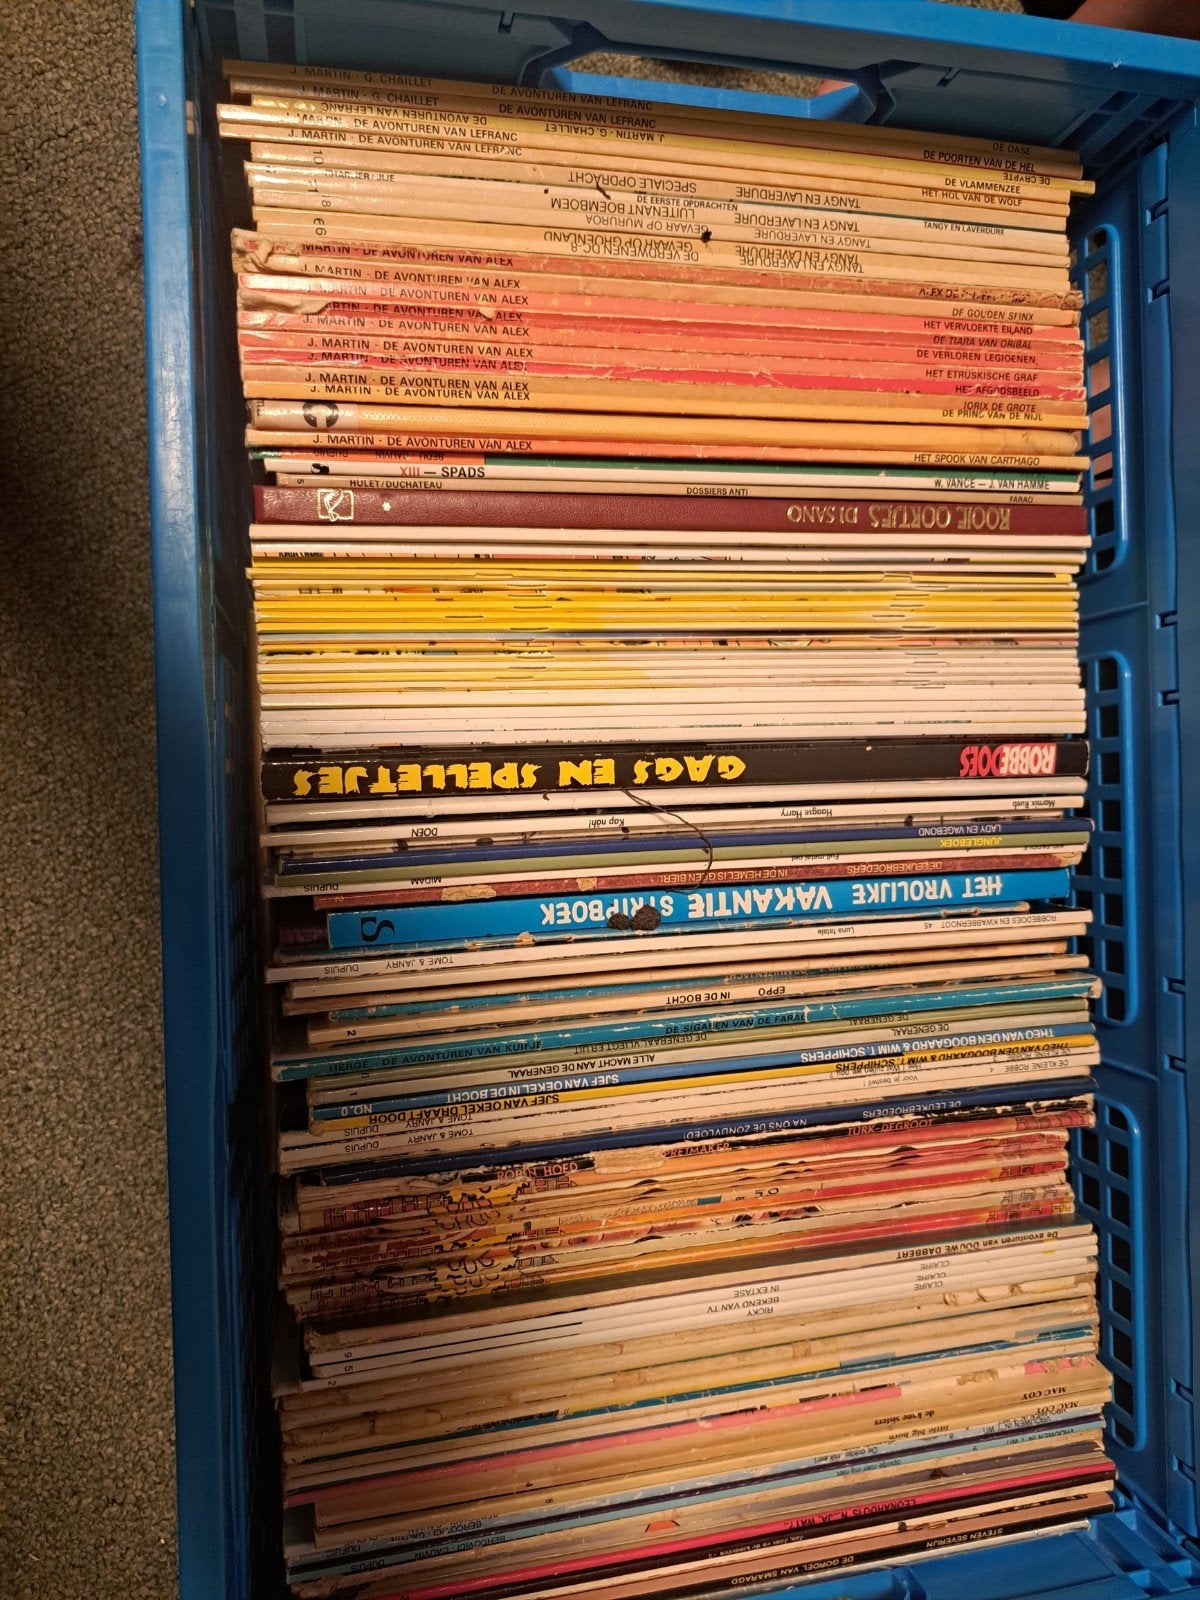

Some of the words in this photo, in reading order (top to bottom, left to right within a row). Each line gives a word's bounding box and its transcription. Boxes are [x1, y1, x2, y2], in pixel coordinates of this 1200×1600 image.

[377, 107, 399, 116] VAN
[402, 109, 470, 123] AVONTUREN
[500, 104, 513, 114] DE
[516, 105, 581, 121] AVONTUREN
[584, 113, 607, 123] VAN
[610, 115, 656, 128] LEFRANC
[473, 115, 487, 125] DE
[924, 150, 936, 159] DE
[939, 152, 981, 166] POORTEN
[984, 157, 1002, 167] VAN
[1005, 160, 1016, 169] DE
[1019, 161, 1036, 172] HEL
[568, 171, 636, 187] OPDRACHT
[639, 178, 696, 193] SPECIALE
[945, 178, 957, 186] DE
[959, 179, 1020, 194] VLAMMENZEE
[736, 186, 802, 202] LAVERDURE
[804, 193, 821, 204] EN
[551, 198, 623, 214] BOEMBOEM
[651, 196, 680, 207] EERSTE
[683, 199, 738, 211] OPDRACHTEN
[828, 196, 860, 208] TANGY
[626, 206, 695, 219] LUITENANT
[924, 221, 948, 230] TANGY
[962, 225, 1005, 235] LAVERDURE
[755, 229, 817, 243] LAVERDURE
[821, 235, 834, 244] EN
[837, 237, 871, 247] TANGY
[924, 321, 941, 329] HET
[944, 322, 999, 332] VERVLOEKTE
[308, 338, 317, 346] J.
[323, 338, 369, 349] MARTIN
[383, 341, 398, 350] DE
[400, 342, 475, 354] AVONTUREN
[478, 345, 500, 355] VAN
[506, 347, 533, 357] ALEX
[917, 350, 929, 358] DE
[932, 350, 981, 361] VERLOREN
[925, 369, 943, 378] HET
[947, 370, 1010, 381] ETRUSKISCHE
[1014, 373, 1038, 382] GRAF
[313, 434, 323, 444] J.
[327, 435, 374, 446] MARTIN
[387, 437, 402, 446] DE
[405, 437, 475, 449] AVONTUREN
[479, 439, 501, 449] VAN
[506, 440, 532, 450] ALEX
[914, 453, 932, 463] HET
[935, 454, 965, 464] SPOOK
[968, 455, 987, 464] VAN
[991, 456, 1040, 466] CARTHAGO
[400, 467, 420, 477] XIII
[441, 466, 485, 478] SPADS
[350, 479, 442, 489] HULET/DUCHATEAU
[934, 478, 944, 488] W.
[946, 478, 975, 488] VANCE
[989, 479, 996, 489] J.
[998, 480, 1014, 489] VAN
[1018, 480, 1049, 490] HAMME
[686, 487, 728, 496] DOSSIERS
[730, 487, 748, 496] ANTI
[1009, 495, 1033, 504] FARAO
[787, 504, 834, 525] SANO
[869, 505, 952, 530] OORTJES
[960, 743, 1057, 777] ROBBEDOES
[558, 758, 615, 787] EN
[632, 754, 746, 784] GAGS
[293, 761, 542, 796] SPELLETJES
[781, 809, 802, 818] Harry
[804, 808, 832, 818] Haagse
[411, 828, 438, 838] DOEN
[919, 826, 964, 836] VAGEBOND
[978, 824, 1001, 834] LADY
[940, 837, 1002, 847] JUNGLEBOEK
[962, 875, 1002, 897] HET
[852, 880, 953, 904] VROLIJKE
[688, 885, 833, 918] VAKANTIE
[941, 917, 1000, 928] KWABBERNOOT
[1012, 915, 1056, 925] ROBBEDOES
[386, 960, 415, 969] JANRY
[428, 956, 454, 965] TOME
[324, 964, 359, 974] DUPUIS
[758, 986, 785, 996] EPPO
[666, 994, 701, 1004] BOCHT
[703, 993, 717, 1001] DE
[891, 1025, 936, 1035] GENERAAL
[1025, 1028, 1054, 1039] THEO
[977, 1033, 1000, 1044] DEN
[1002, 1031, 1024, 1042] VAN
[878, 1043, 900, 1054] WIM
[911, 1036, 975, 1050] BOOGAARD
[633, 1054, 655, 1063] ALLE
[801, 1047, 866, 1063] SCHIPPERS
[578, 1061, 597, 1070] AAN
[599, 1057, 631, 1068] MACHT
[508, 1066, 561, 1077] GENERAAL
[565, 1079, 589, 1089] VAN
[592, 1075, 619, 1085] SJEF
[491, 1088, 507, 1096] DE
[523, 1082, 562, 1094] OEKEL
[447, 1091, 487, 1103] BOCHT
[863, 1102, 946, 1118] LEUKEBROEDERS
[948, 1101, 961, 1109] DE
[768, 1121, 790, 1130] ONS
[792, 1118, 807, 1126] NA
[683, 1125, 750, 1139] ZONDVLOED!
[752, 1124, 766, 1132] DE
[1002, 1234, 1045, 1245] avonturen
[896, 1247, 941, 1259] DABBERT
[944, 1242, 979, 1254] DOUWE
[920, 1260, 949, 1270] CLAIRE
[734, 1287, 768, 1296] EXTASE
[914, 1281, 943, 1291] CLAIRE
[720, 1302, 740, 1311] VAN
[742, 1297, 779, 1307] BEKEND
[1022, 1390, 1042, 1400] COY
[1045, 1387, 1067, 1397] MAC
[971, 1528, 1003, 1540] STEVEN
[927, 1534, 968, 1547] SEVERIJN
[802, 1560, 835, 1571] GORDEL
[839, 1556, 854, 1564] DE
[780, 1567, 799, 1575] VAN
[731, 1570, 778, 1585] SMARAGD
